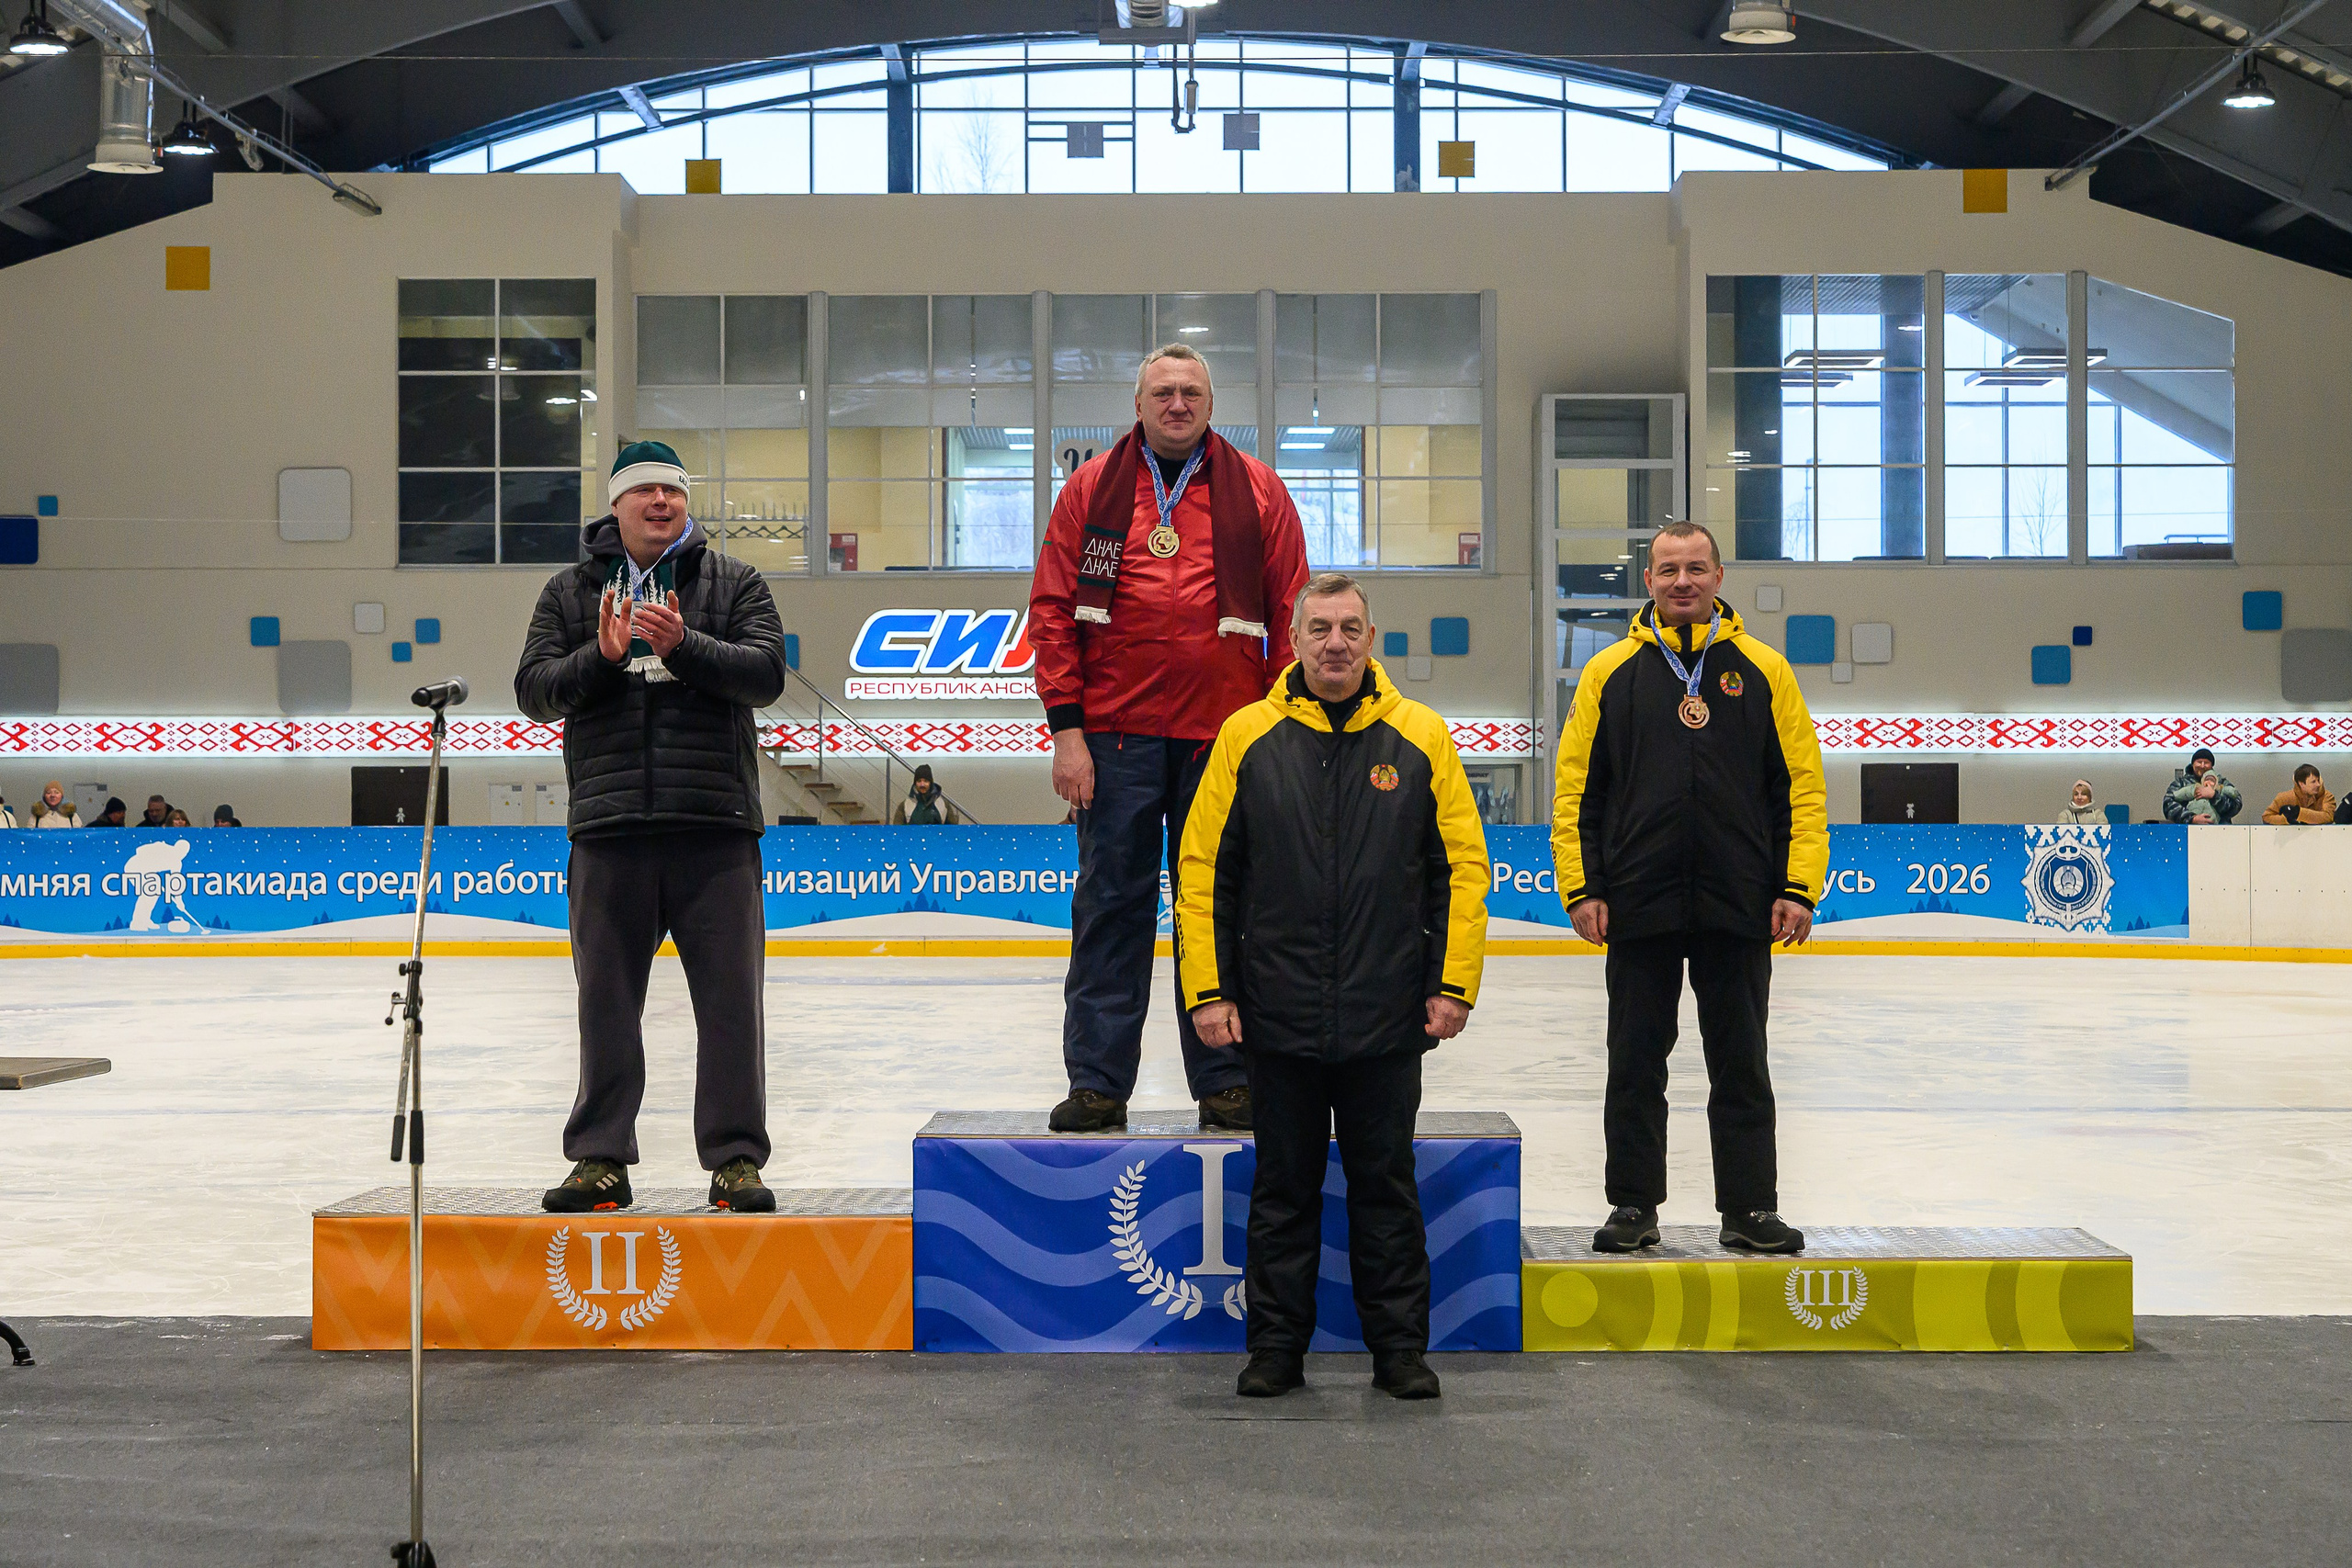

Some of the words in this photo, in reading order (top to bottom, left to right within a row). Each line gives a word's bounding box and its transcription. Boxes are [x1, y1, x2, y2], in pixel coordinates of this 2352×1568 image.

[850, 682, 1036, 694] РЕСПУБЛИКАНСК
[0, 873, 91, 897] мняя
[101, 871, 328, 904] спартакиада
[337, 871, 442, 903] среди
[909, 863, 1079, 901] Управлен
[1906, 863, 1991, 895] 2026
[582, 1231, 645, 1294] II
[1799, 1269, 1854, 1306] III
